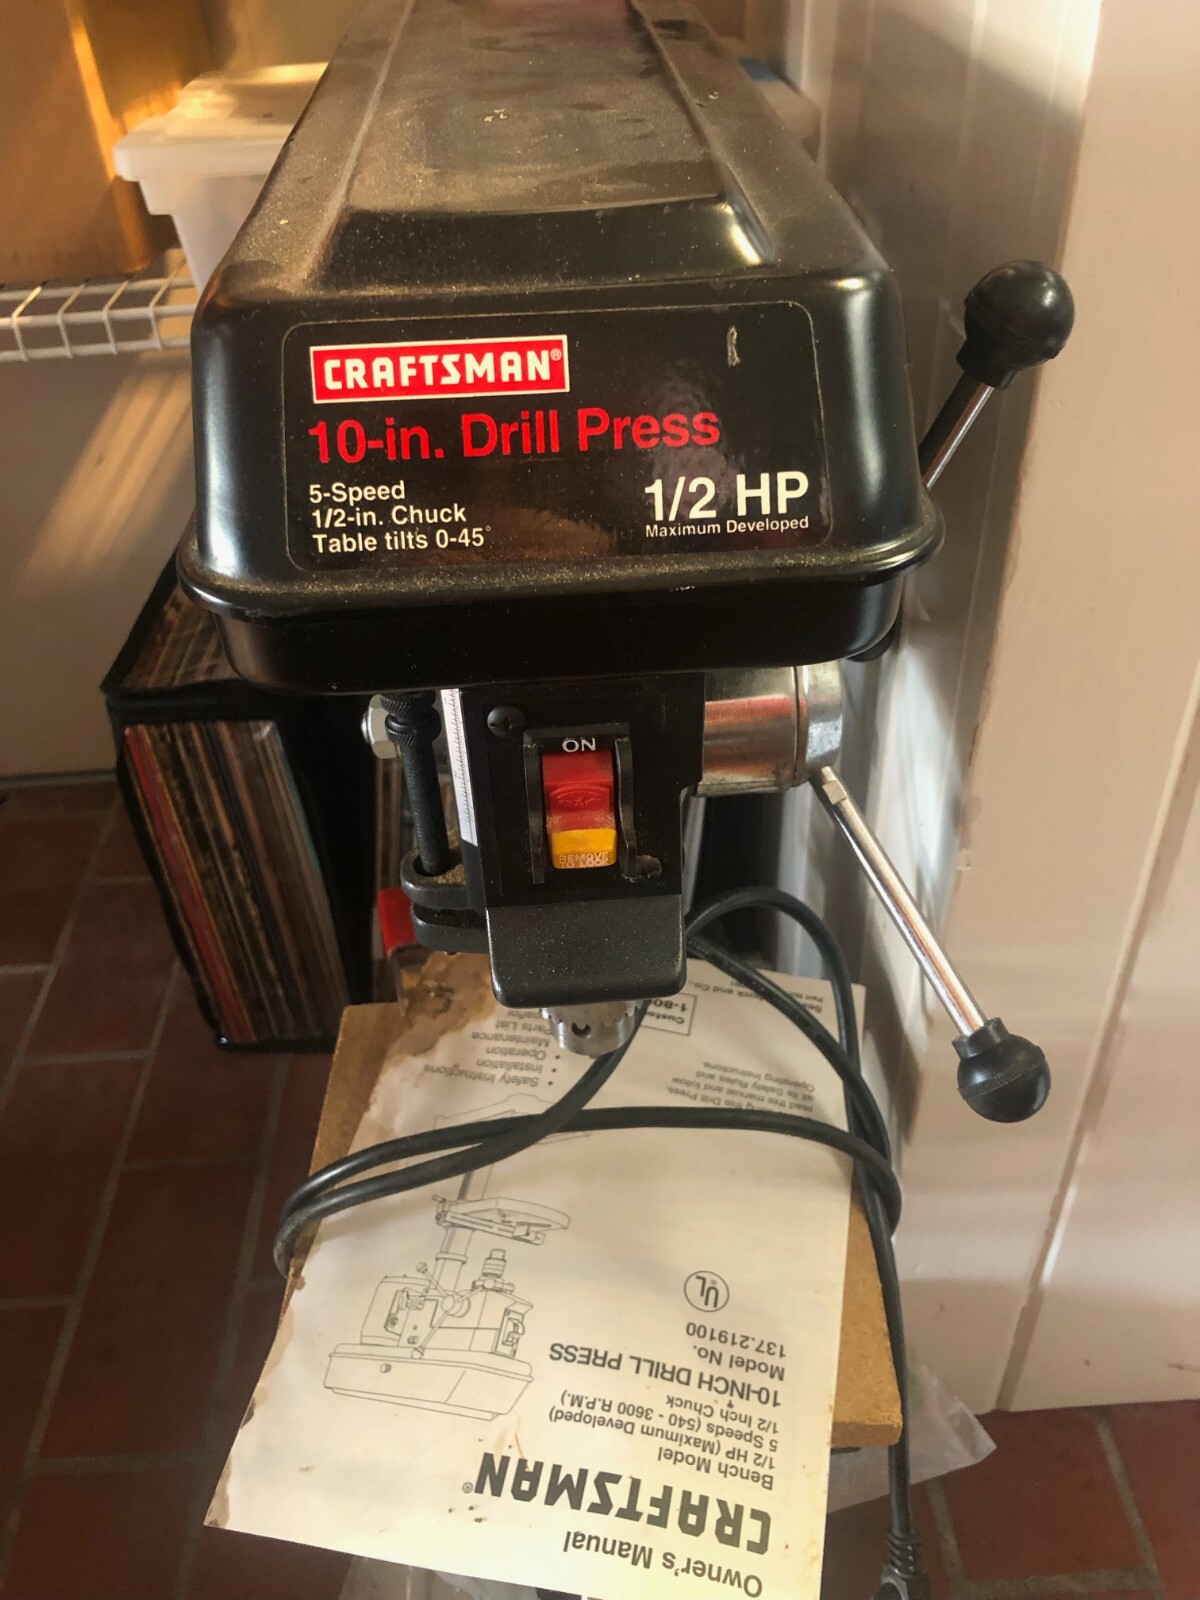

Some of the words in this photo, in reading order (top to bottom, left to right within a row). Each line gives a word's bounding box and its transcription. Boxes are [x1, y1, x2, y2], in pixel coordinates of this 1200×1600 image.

[308, 418, 444, 463] 10-in.
[462, 410, 559, 458] Drill
[578, 407, 720, 451] Press
[309, 481, 406, 505] 5-Speed
[644, 477, 717, 521] 1/2
[738, 472, 809, 516] HP
[311, 508, 384, 529] 1/2-in.
[391, 504, 467, 525] Chuck
[645, 521, 721, 538] Maximum
[726, 517, 809, 533] Developed
[313, 533, 377, 555] Table
[384, 530, 429, 551] tilts
[562, 738, 596, 752] ON
[560, 852, 608, 862] REMOVE
[712, 984, 734, 995] and
[495, 1020, 517, 1031] List
[646, 1011, 685, 1025] Custo
[521, 1022, 551, 1036] Parts
[471, 1032, 550, 1047] Maintenance
[485, 1046, 547, 1061] Operation
[423, 1064, 496, 1084] Instructions
[476, 1059, 543, 1073] Installation
[695, 1070, 716, 1081] and
[498, 1072, 539, 1087] Safety
[671, 1077, 701, 1090] follow
[704, 1083, 724, 1094] and
[718, 1075, 749, 1089] Rules
[751, 1081, 784, 1097] Safety
[764, 1073, 815, 1093] Operating
[700, 1094, 721, 1106] Drill
[726, 1088, 765, 1103] manual
[768, 1096, 786, 1107] this
[788, 1101, 813, 1112] read
[685, 1322, 787, 1358] 137.219100
[549, 1343, 623, 1370] PRESS
[692, 1345, 723, 1366] No.
[628, 1355, 692, 1387] DRILL
[729, 1354, 785, 1381] Model
[697, 1371, 782, 1407] 10-INCH
[560, 1389, 613, 1413] R.P.M.)
[617, 1401, 654, 1421] 3600
[665, 1394, 715, 1418] Chuck
[548, 1406, 636, 1435] Developed)
[667, 1413, 702, 1433] (540
[719, 1408, 753, 1428] Inch
[757, 1418, 779, 1434] 1/2
[640, 1424, 721, 1456] (Maximum
[706, 1422, 764, 1449] Speeds
[768, 1438, 779, 1453] 5
[657, 1446, 712, 1474] Model
[725, 1446, 748, 1464] HP
[753, 1453, 776, 1470] 1/2
[717, 1461, 774, 1491] Bench
[562, 1531, 653, 1570] Manual
[661, 1552, 763, 1598] Owner's
